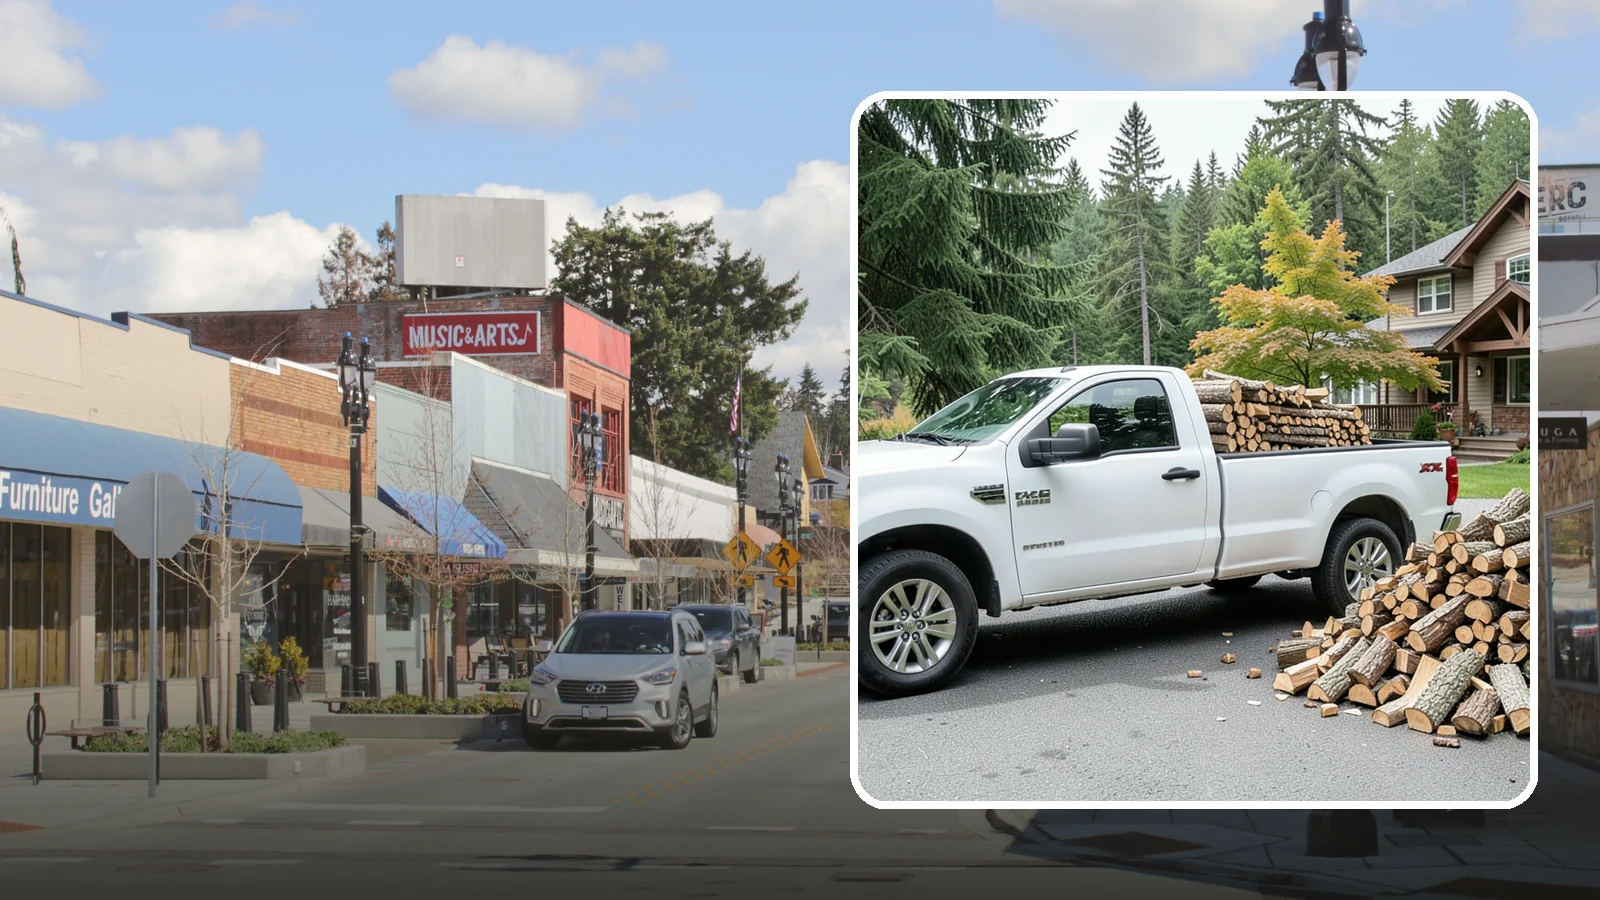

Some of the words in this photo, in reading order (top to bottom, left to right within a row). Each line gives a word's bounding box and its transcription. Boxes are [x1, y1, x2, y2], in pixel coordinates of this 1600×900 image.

[408, 322, 520, 349] MUSIC&ARTS
[0, 471, 80, 516] Furniture
[89, 482, 122, 519] Gal
